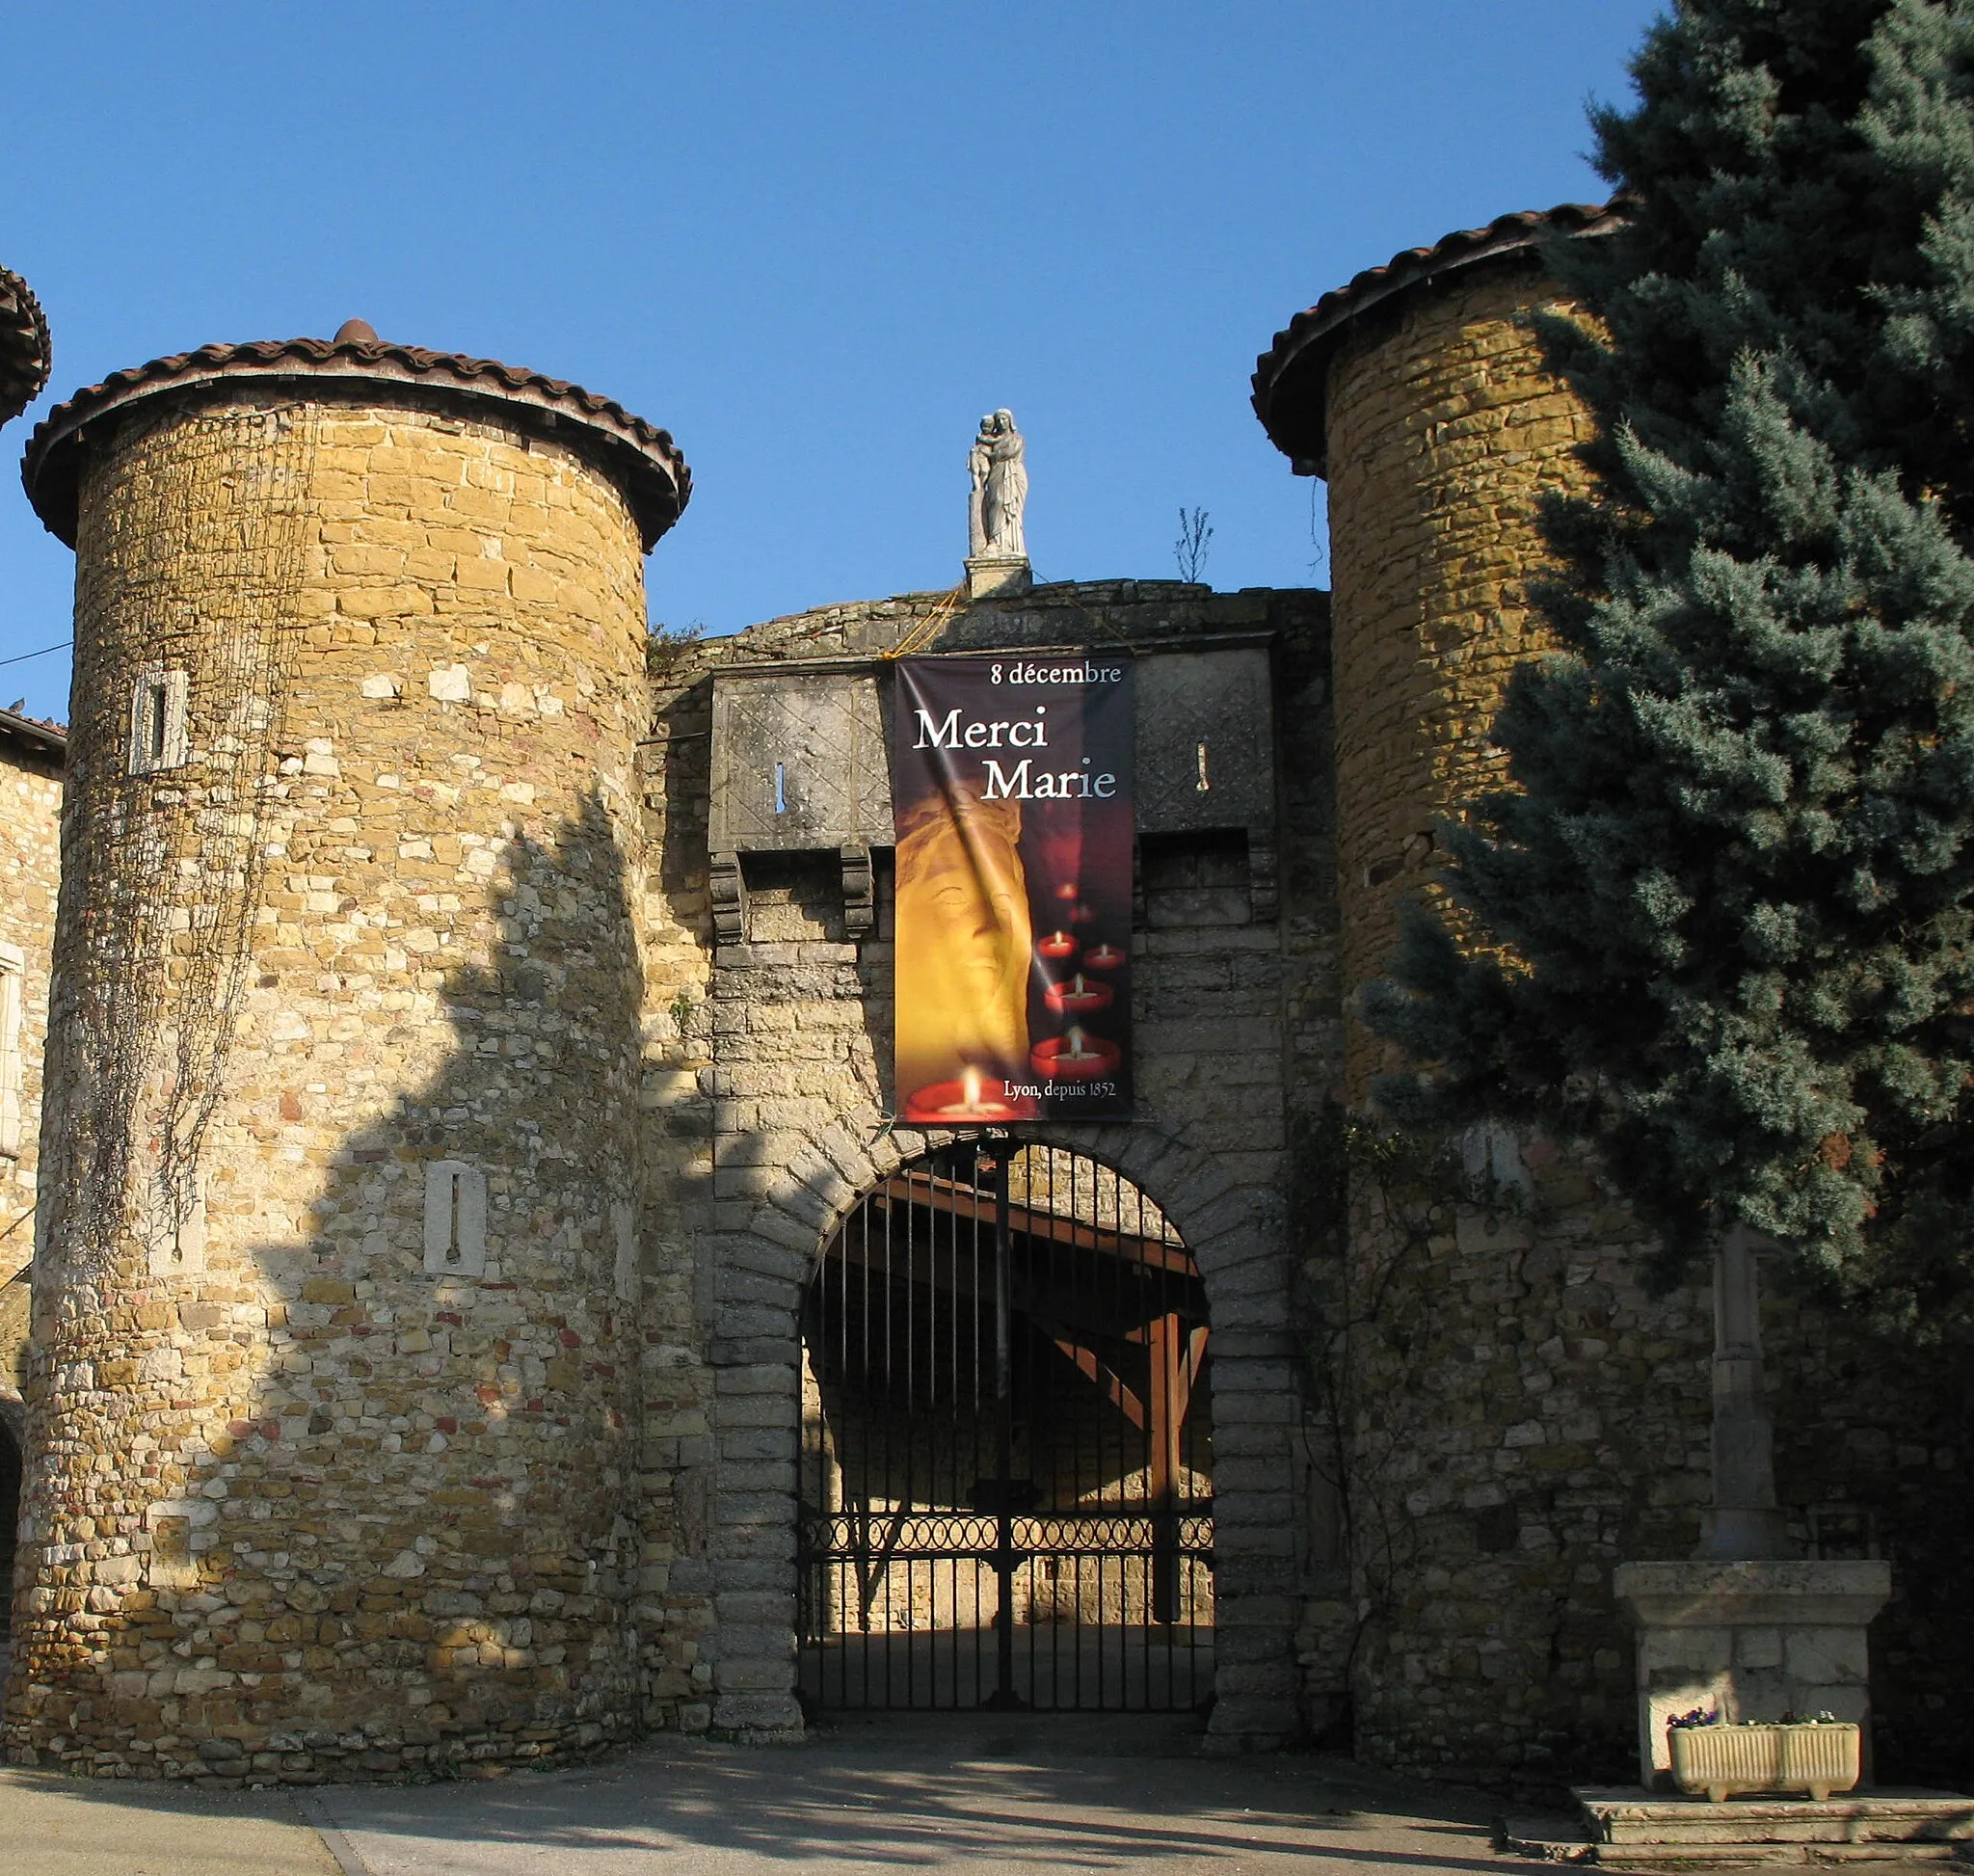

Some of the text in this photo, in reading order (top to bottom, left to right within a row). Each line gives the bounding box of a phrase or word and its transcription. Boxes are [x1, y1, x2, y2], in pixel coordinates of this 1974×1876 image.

[990, 660, 1122, 684] 8 décembre
[912, 706, 1049, 749] Merci
[979, 757, 1117, 800] Marie
[1003, 1079, 1116, 1101] Lyon, depuis 1852
